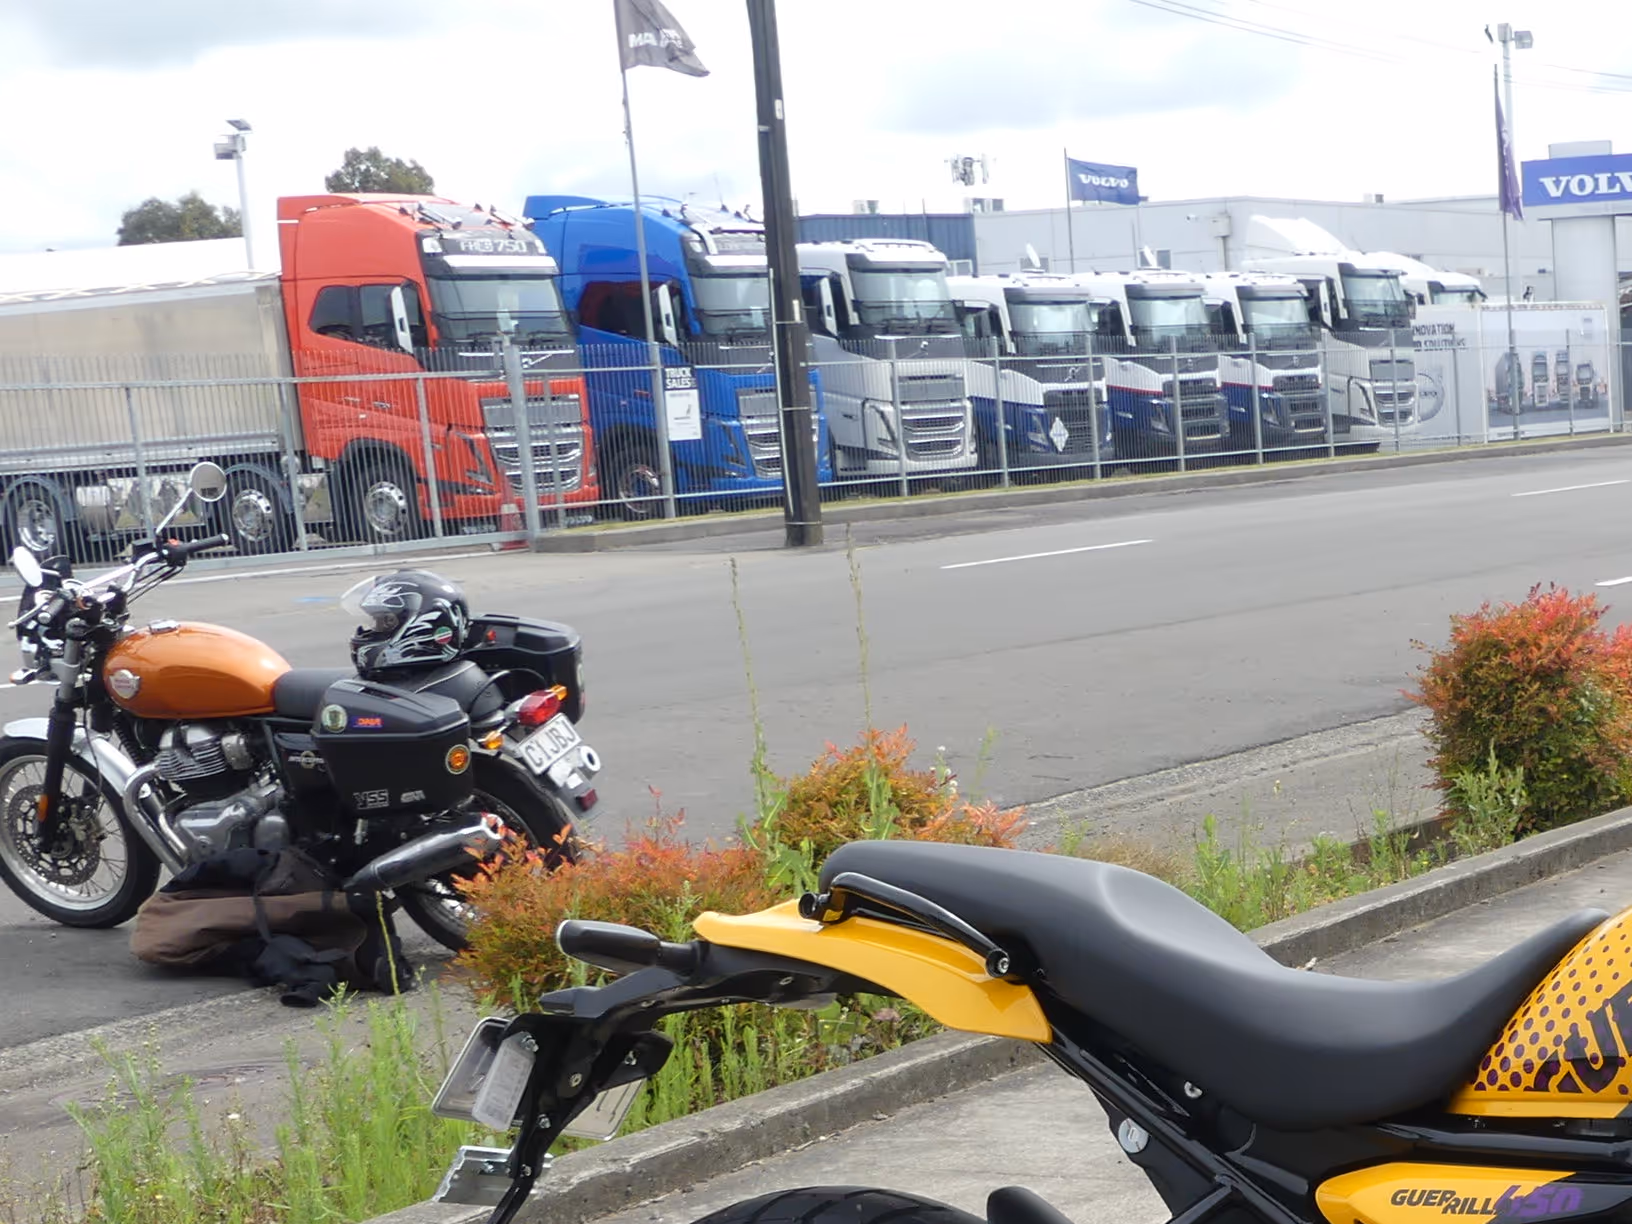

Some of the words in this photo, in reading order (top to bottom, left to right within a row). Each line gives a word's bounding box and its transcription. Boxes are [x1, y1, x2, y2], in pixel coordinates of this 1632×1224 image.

[1078, 173, 1129, 189] VOLVO
[664, 367, 692, 378] TRUCK
[666, 378, 693, 389] SALES
[1390, 1189, 1501, 1216] GUERRILL
[1493, 1184, 1586, 1217] 450
